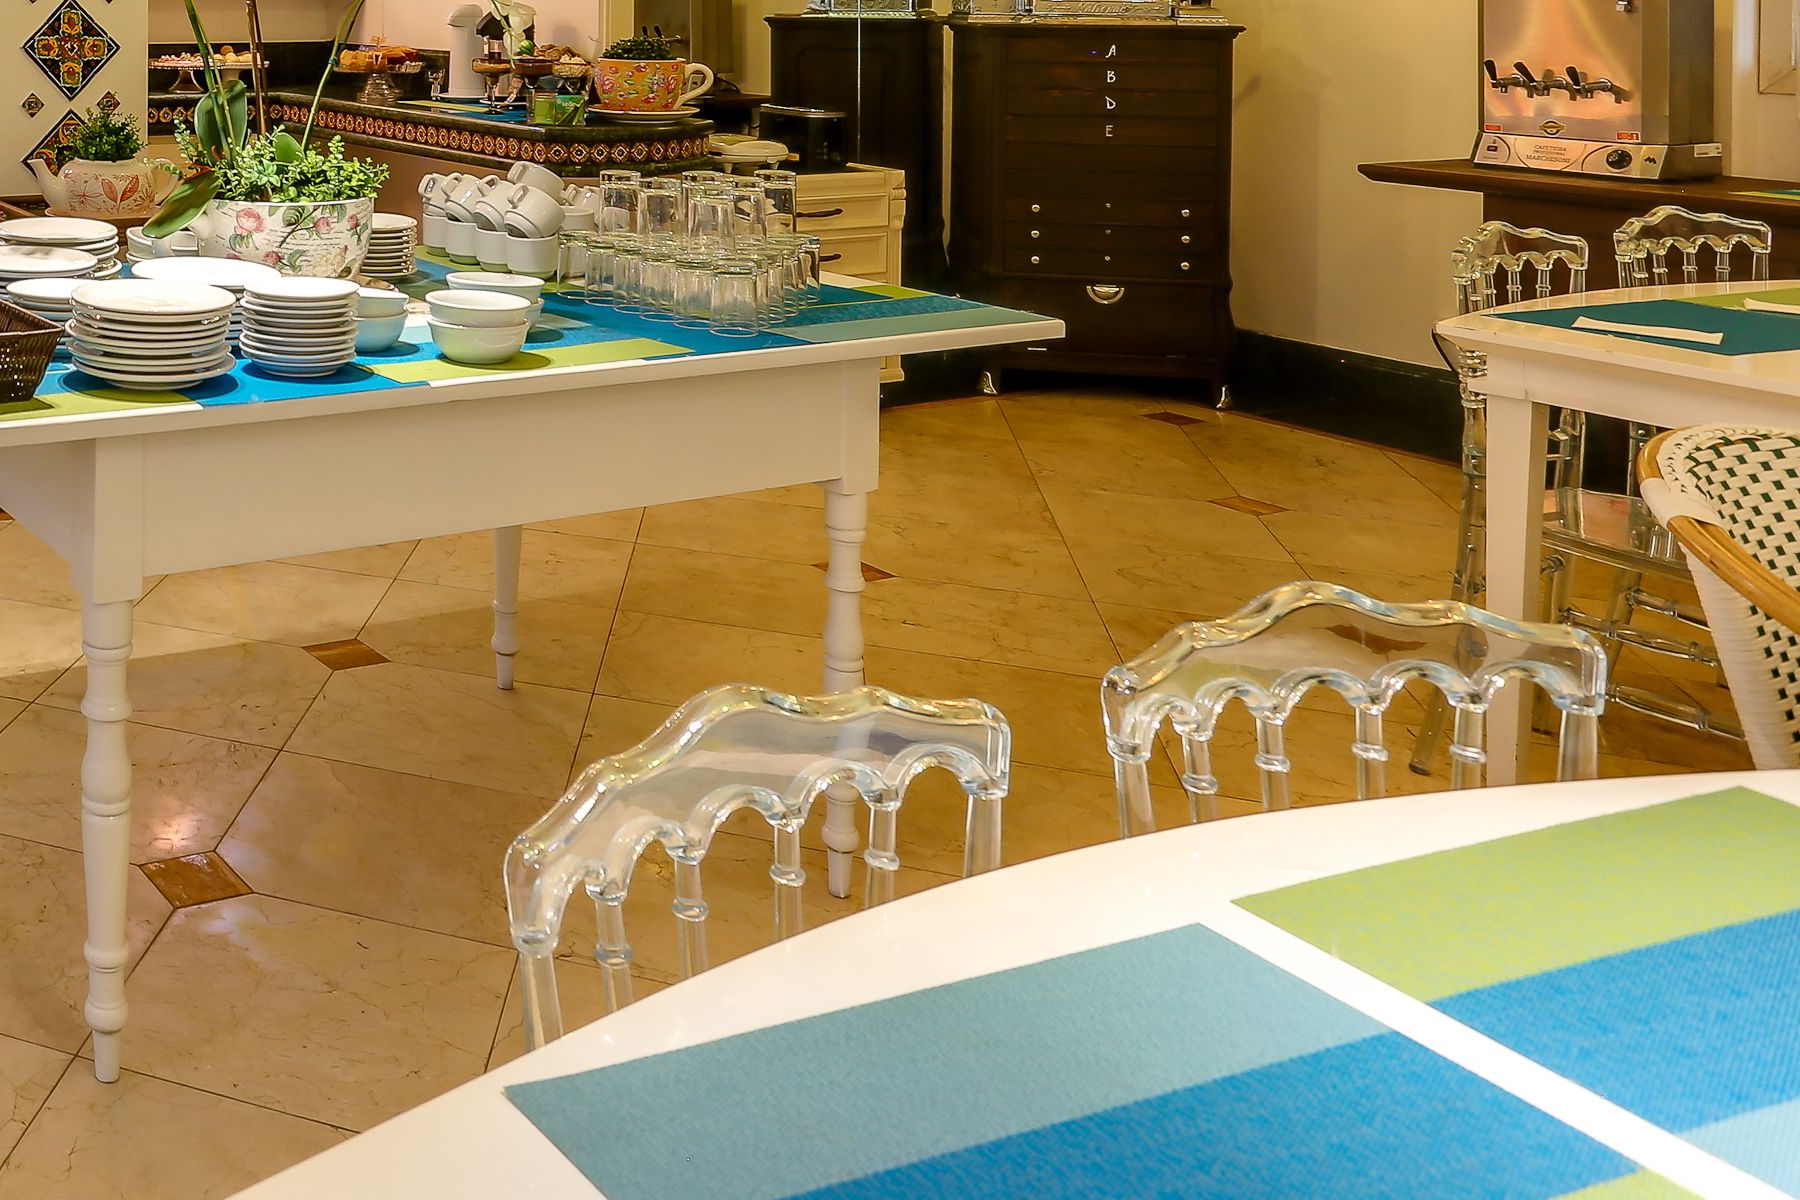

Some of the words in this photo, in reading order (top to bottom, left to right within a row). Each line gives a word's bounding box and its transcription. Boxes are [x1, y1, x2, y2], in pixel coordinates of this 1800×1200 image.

[1105, 44, 1116, 58] A
[1107, 70, 1116, 83] B
[1105, 96, 1116, 109] D
[1105, 125, 1114, 137] E
